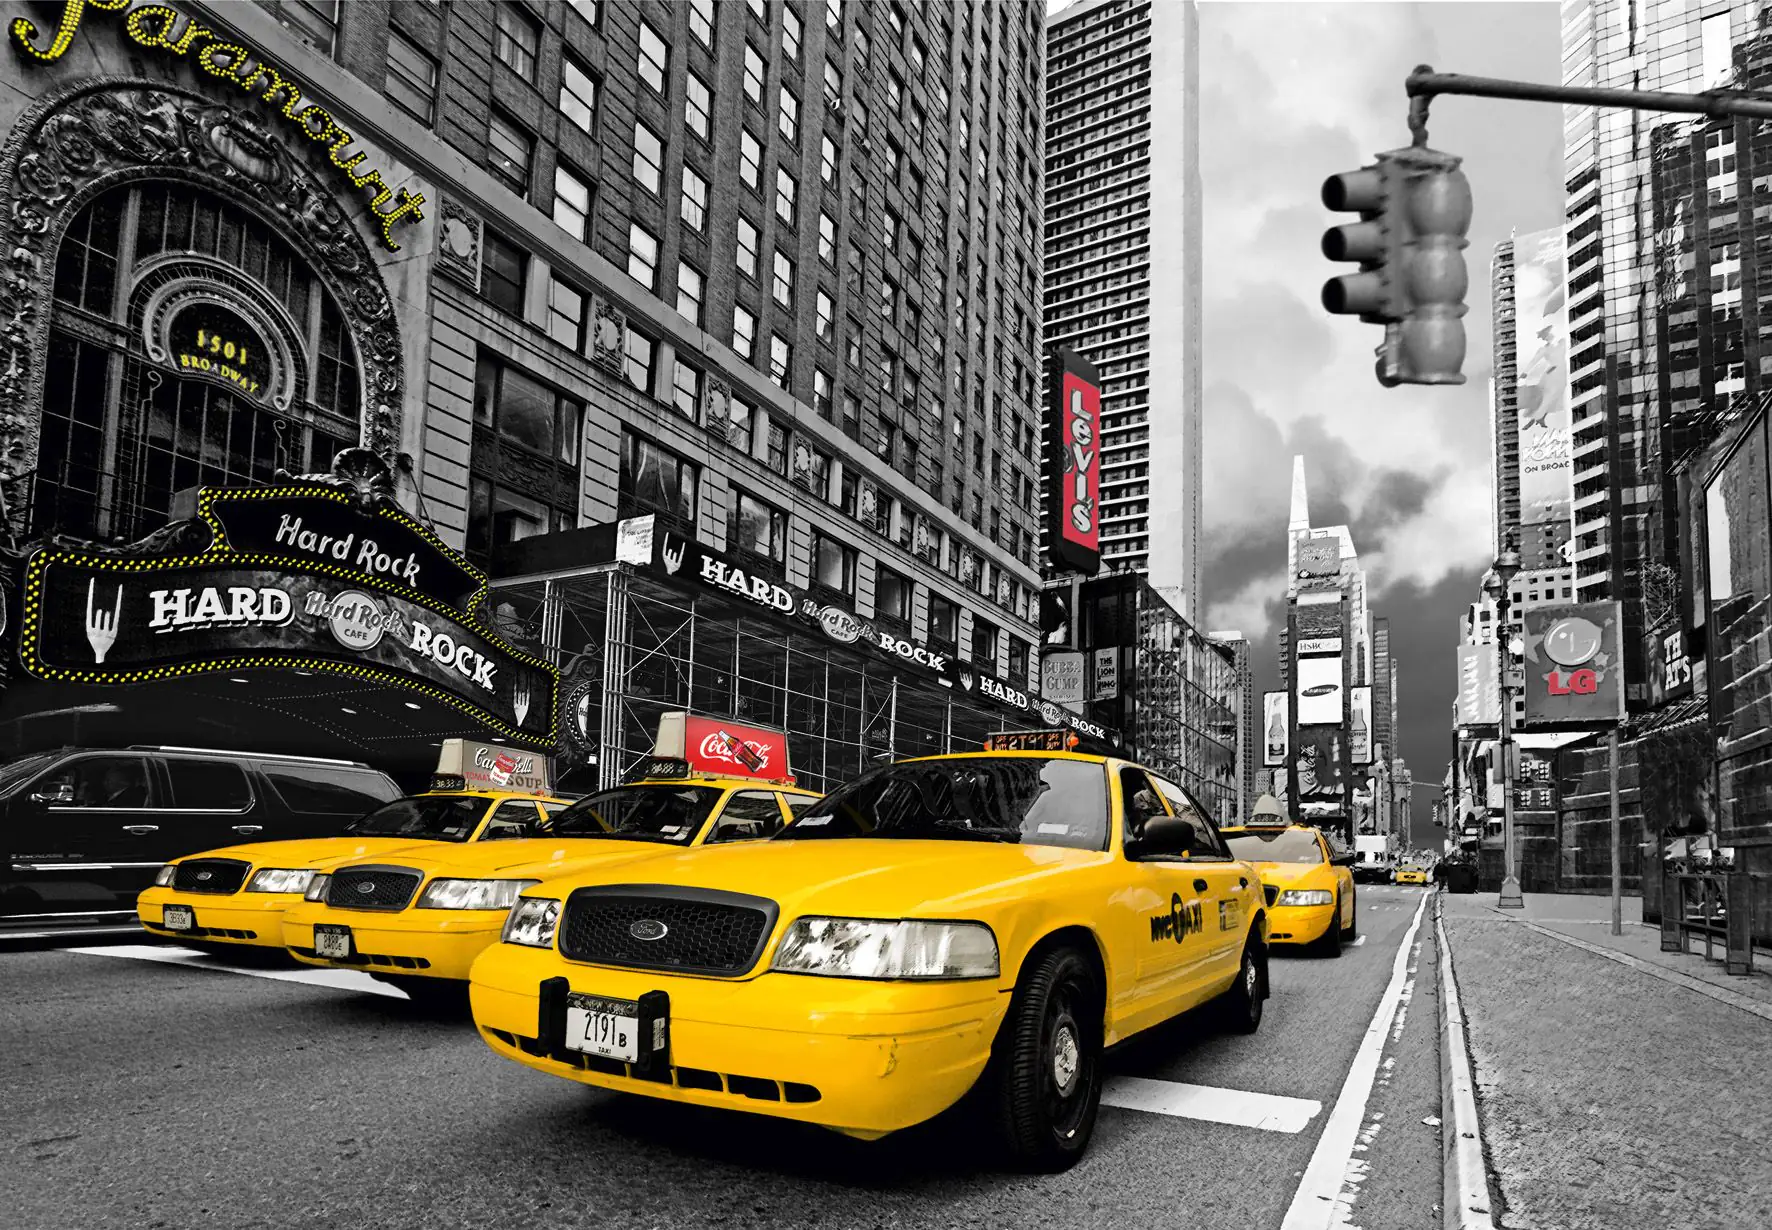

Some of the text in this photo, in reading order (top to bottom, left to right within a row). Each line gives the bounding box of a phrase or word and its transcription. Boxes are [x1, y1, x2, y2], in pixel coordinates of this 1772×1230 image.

[197, 329, 247, 365] 1501
[180, 354, 259, 392] BROADWAY
[1524, 466, 1539, 474] ON
[275, 513, 421, 587] Hard Rock
[700, 554, 796, 616] HARD
[802, 598, 840, 625] Hard
[879, 632, 947, 672] ROCK
[149, 587, 498, 693] HARD Hard Rock ROCK
[344, 628, 368, 641] CAFE
[1044, 660, 1081, 674] BUBBA
[1046, 676, 1078, 690] GUMP
[1547, 669, 1598, 696] LG
[979, 675, 1029, 711] HARD
[1070, 716, 1106, 739] ROCK
[464, 771, 491, 783] TOMAT
[584, 1011, 616, 1046] 2T91
